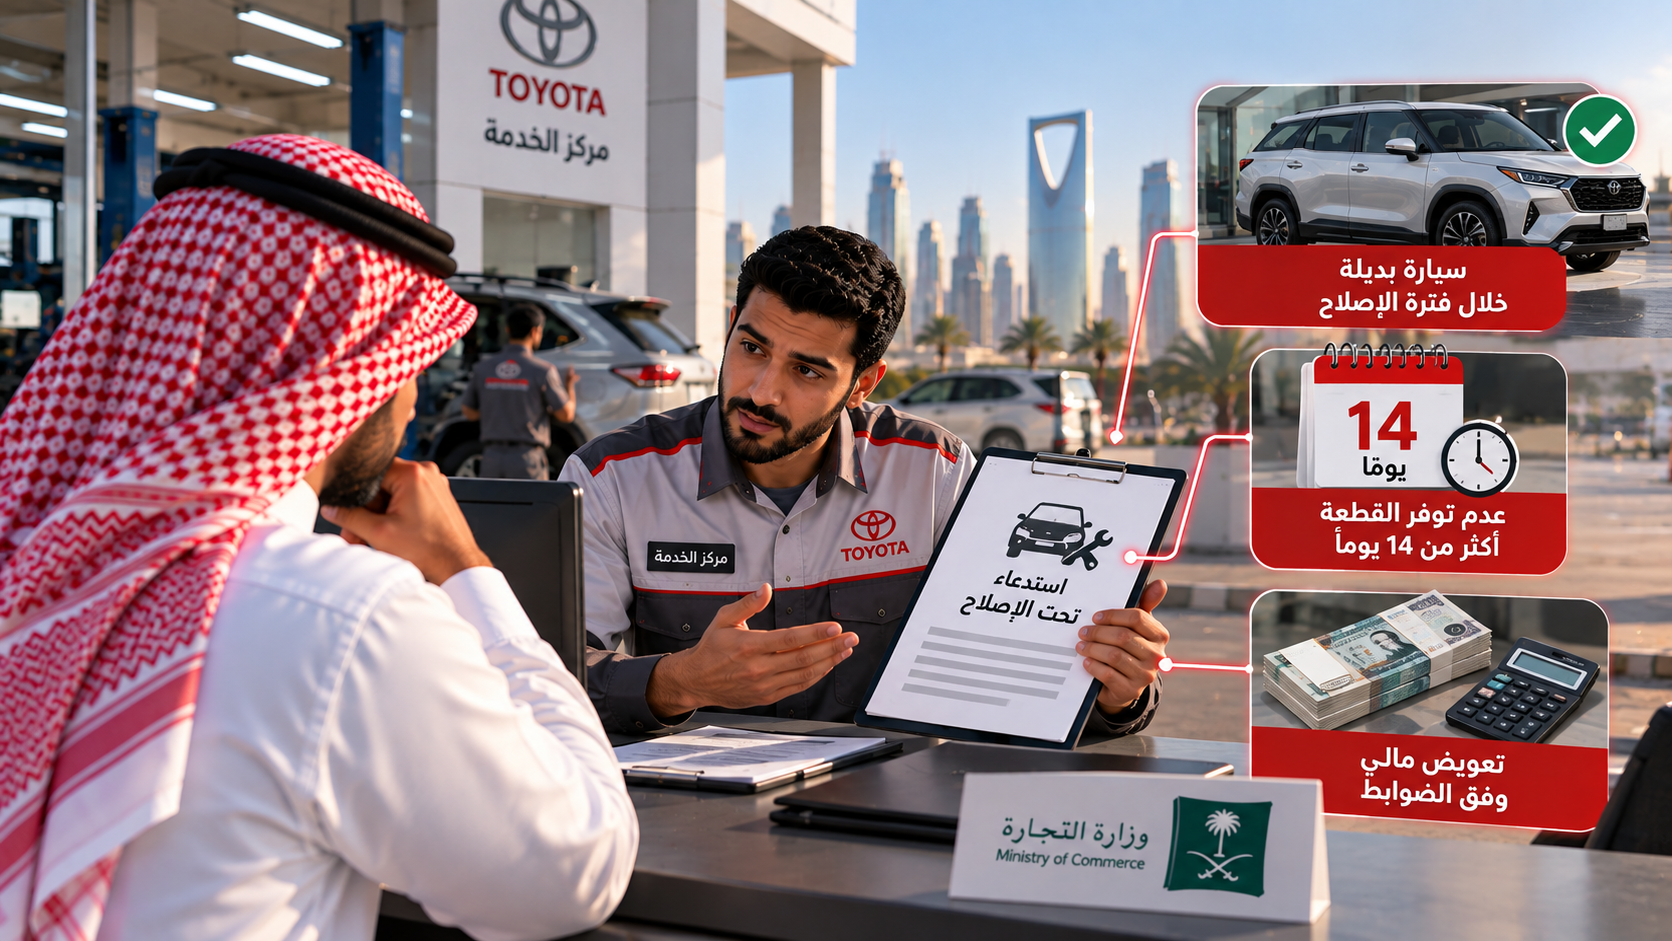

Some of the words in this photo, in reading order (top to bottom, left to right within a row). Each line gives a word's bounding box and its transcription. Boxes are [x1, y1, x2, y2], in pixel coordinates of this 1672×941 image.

[489, 68, 607, 117] TOYOTA
[484, 118, 559, 154] الخدمة
[563, 134, 610, 166] مركز
[654, 549, 697, 564] الخدمة
[699, 551, 728, 568] مركز
[840, 539, 911, 563] TOYOTA
[993, 569, 1069, 595] استدعاء
[1037, 604, 1082, 625] تحت
[1001, 817, 1087, 844] التجارة
[1093, 822, 1149, 850] وزارة
[995, 848, 1050, 868] Ministry
[1053, 852, 1070, 866] of
[1071, 853, 1146, 870] Commerce
